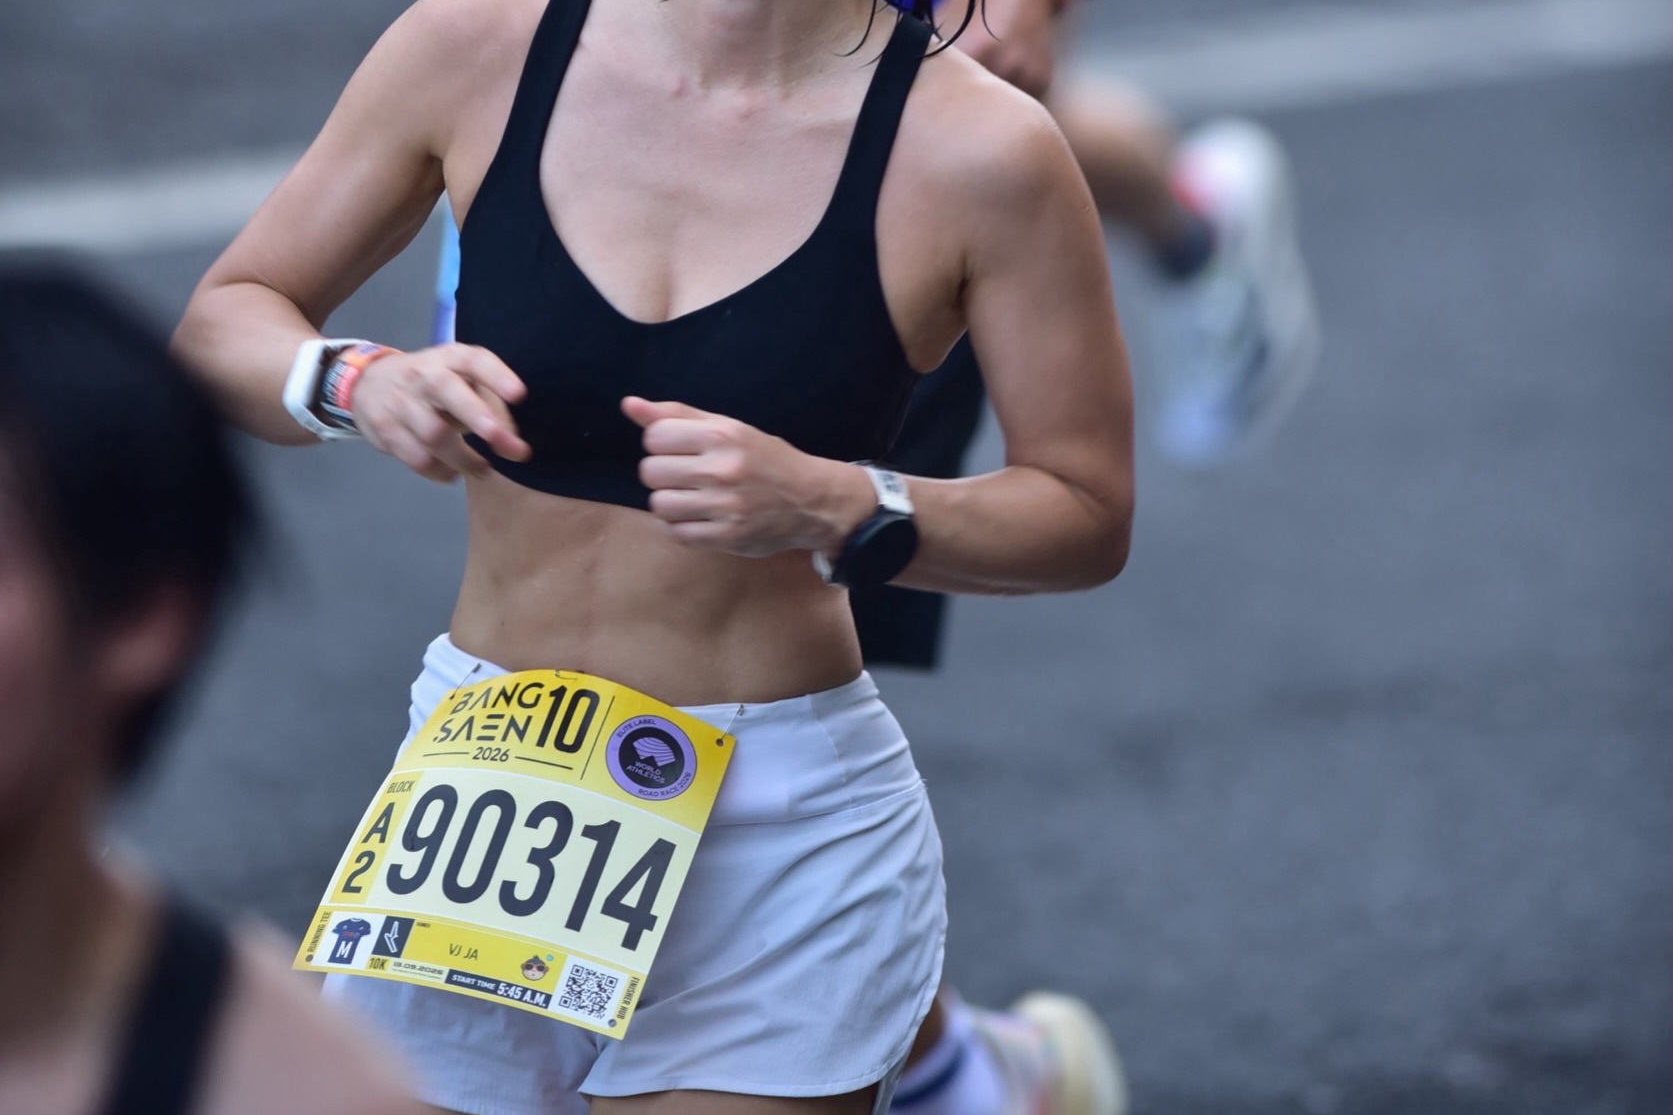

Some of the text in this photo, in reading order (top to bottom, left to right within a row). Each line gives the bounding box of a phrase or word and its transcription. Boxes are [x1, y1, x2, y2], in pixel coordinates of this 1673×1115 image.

[450, 682, 600, 754] BANG 10
[617, 718, 656, 737] ELITE LABEL
[432, 714, 533, 743] SAEN
[472, 746, 510, 762] 2026
[626, 765, 665, 784] ATHLETICS
[635, 761, 662, 775] WORLD
[387, 781, 415, 793] BLOCK
[638, 788, 659, 797] ROAD
[660, 787, 679, 796] RACE
[361, 802, 395, 843] A
[341, 850, 376, 894] 2
[386, 783, 677, 952] 90314
[307, 911, 332, 952] RUNNING TEE
[336, 940, 353, 959] M
[449, 943, 478, 961] VJ JA
[369, 957, 387, 970] 10K
[452, 974, 476, 985] START
[477, 980, 496, 990] TIME
[497, 982, 523, 1000] 5:45
[523, 989, 547, 1007] A.M.
[616, 976, 640, 1020] FINISHER HUB
